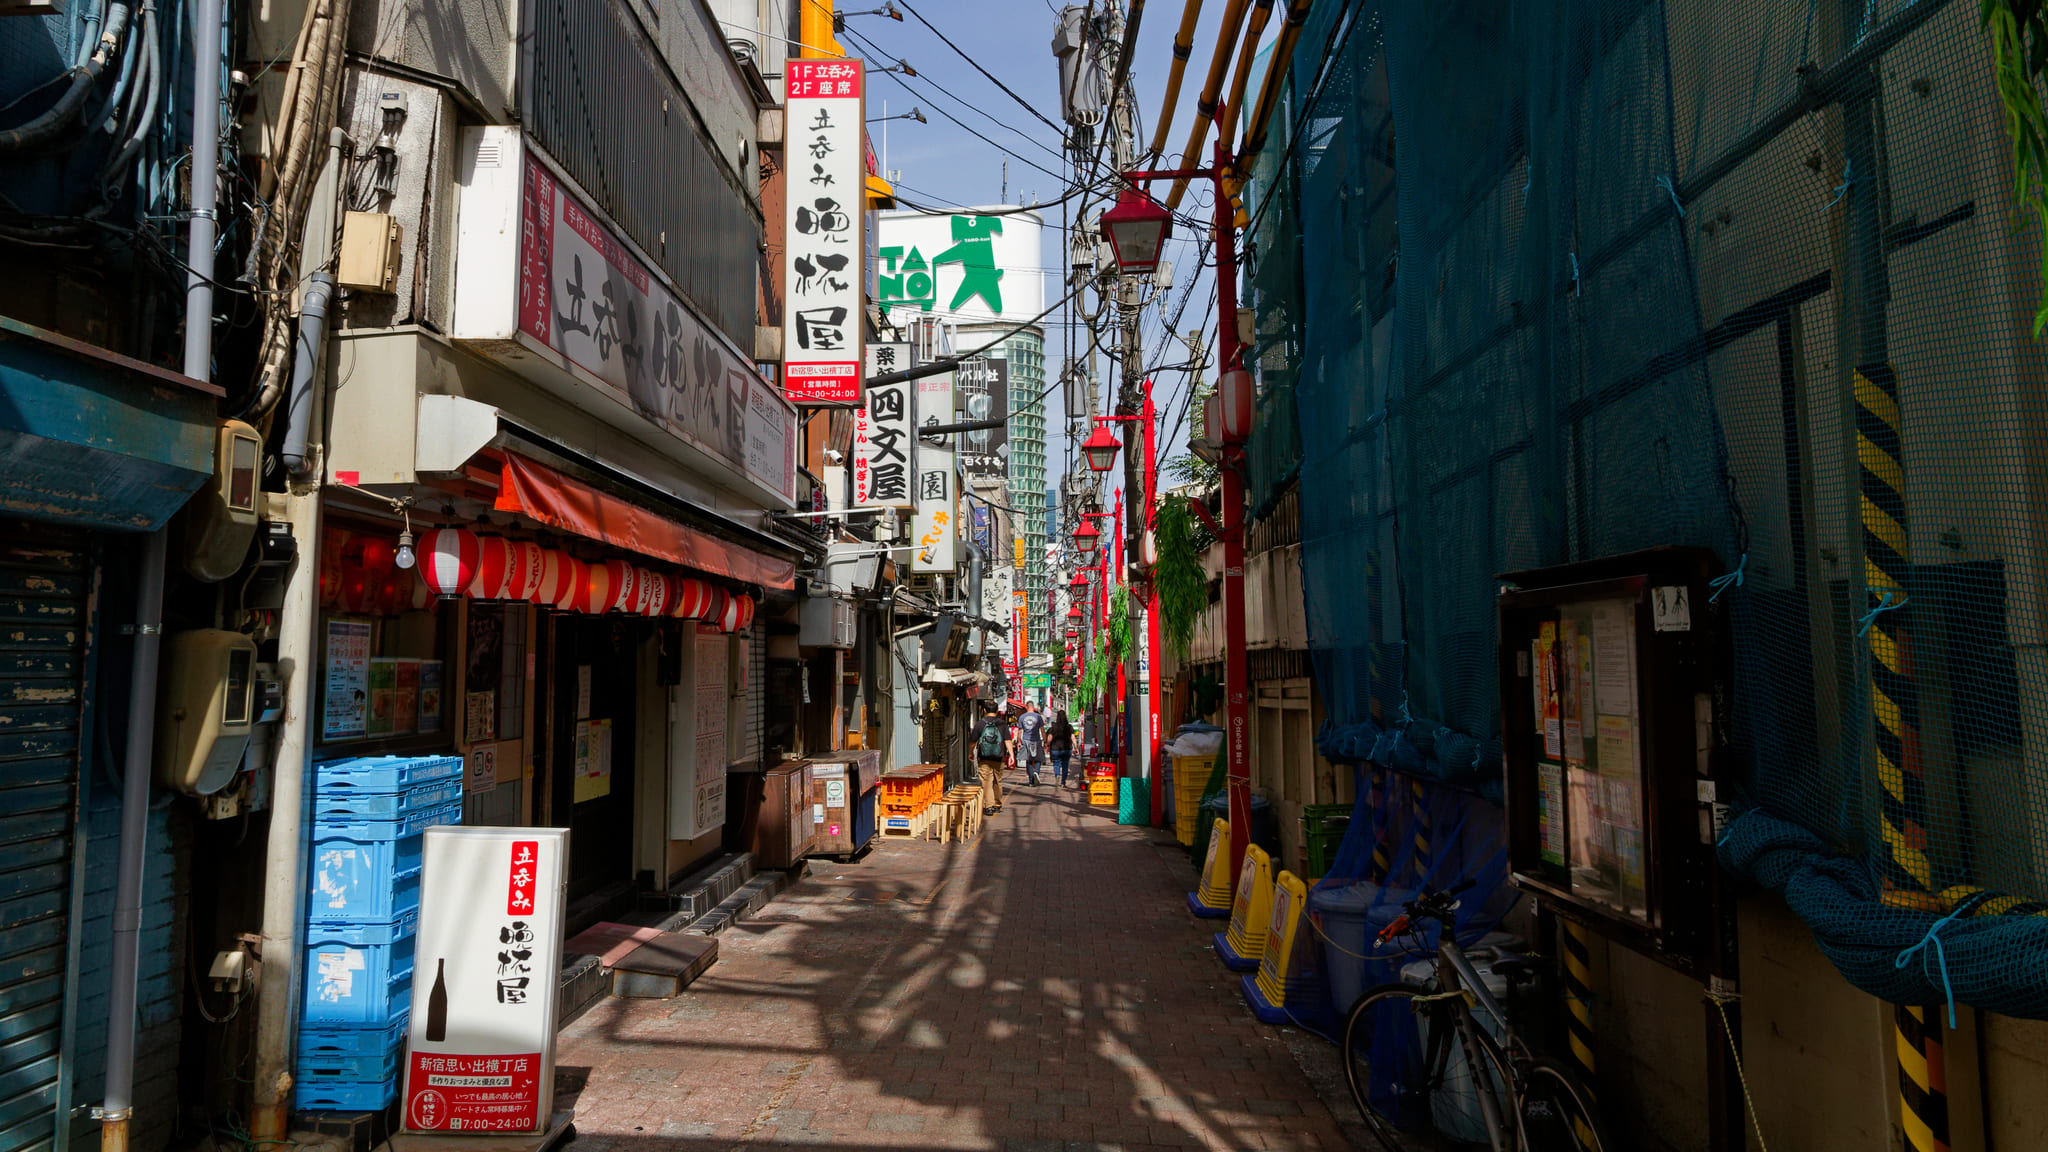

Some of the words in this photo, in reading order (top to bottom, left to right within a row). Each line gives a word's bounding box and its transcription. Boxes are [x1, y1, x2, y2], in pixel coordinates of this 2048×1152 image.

[791, 81, 813, 95] 2F
[818, 80, 851, 95] 座席
[792, 65, 813, 79] 1F
[815, 64, 856, 78] 立呑み
[809, 108, 836, 188] 立呑み
[523, 160, 538, 308] 百十円より
[535, 173, 553, 337] 新鮮おつまみ
[879, 271, 932, 300] NO
[557, 253, 648, 383] 立呑み
[868, 387, 907, 501] 四文屋
[512, 846, 534, 911] 立呑み
[420, 1057, 528, 1073] 新宿思い出横丁店
[430, 1076, 511, 1087] 手作りおつまみと優良な酒
[463, 1117, 531, 1130] 7:00~24:00
